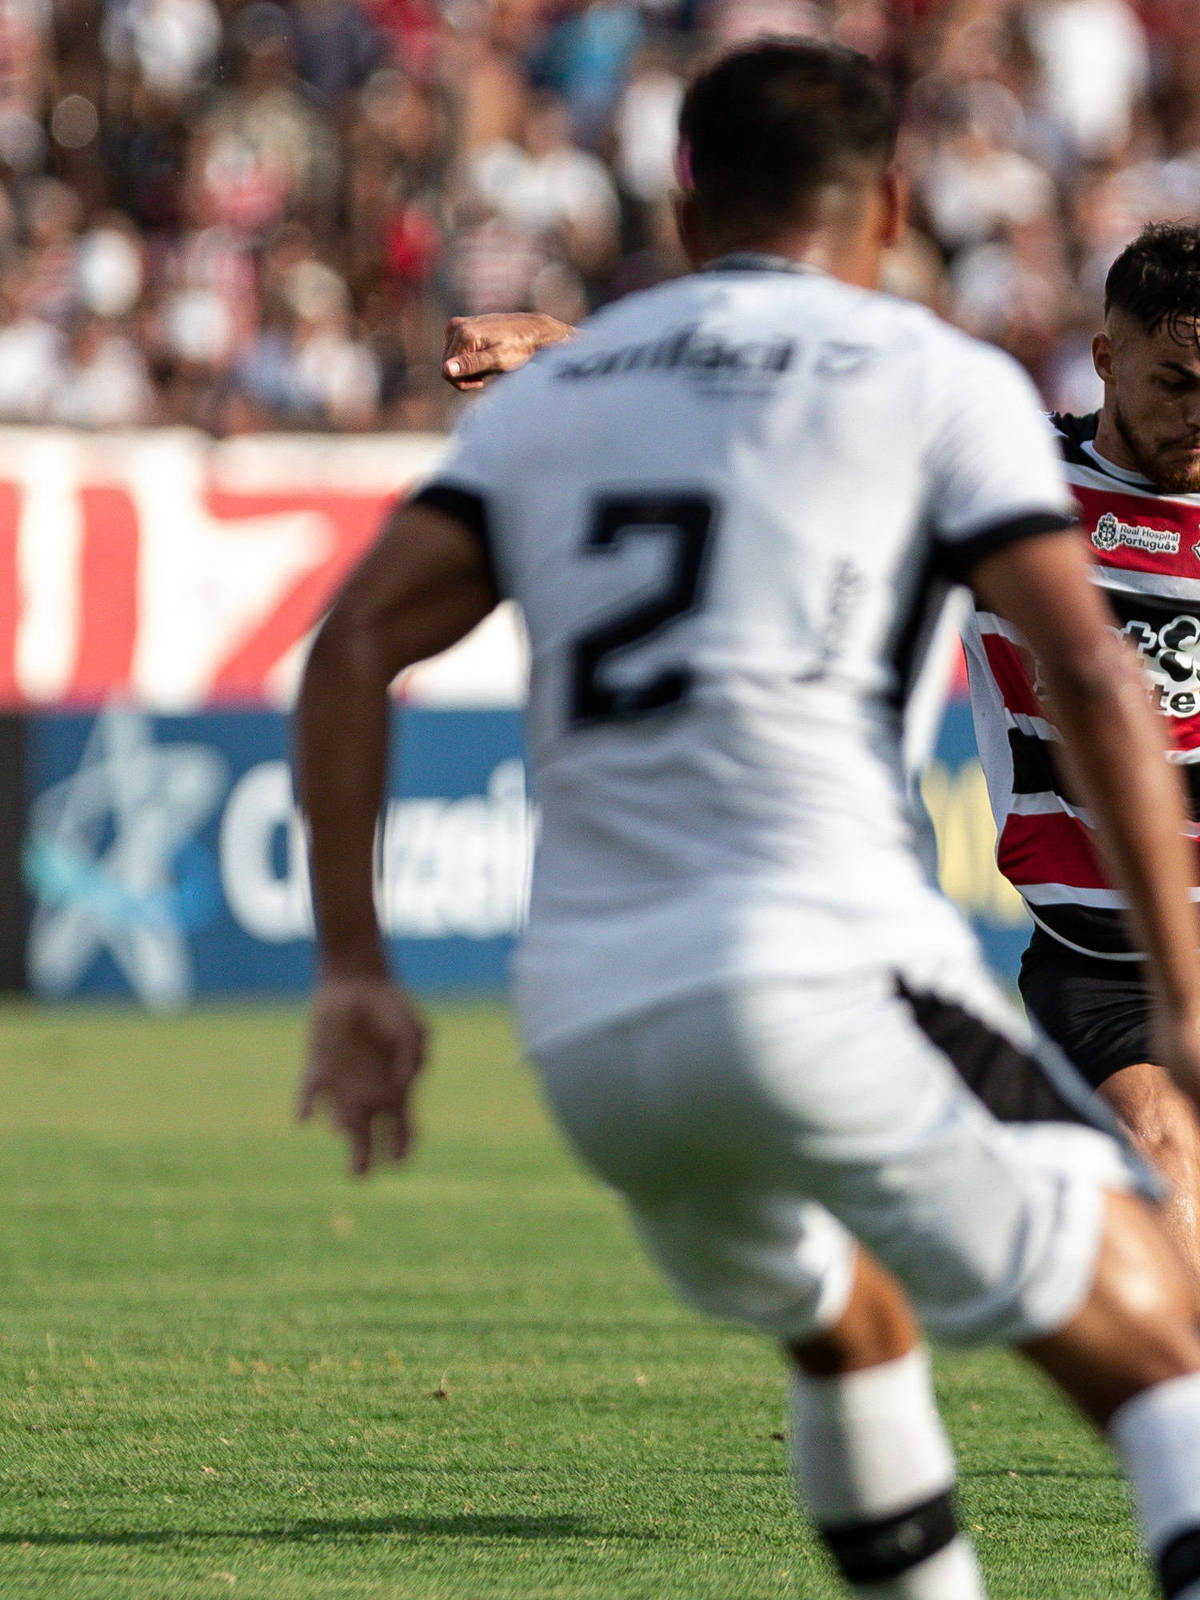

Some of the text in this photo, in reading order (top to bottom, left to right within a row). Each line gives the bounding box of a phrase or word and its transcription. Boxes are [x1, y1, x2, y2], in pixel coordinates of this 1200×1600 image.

[1118, 534, 1178, 552] Português
[1120, 524, 1179, 543] Real Hospital
[570, 494, 720, 724] 2
